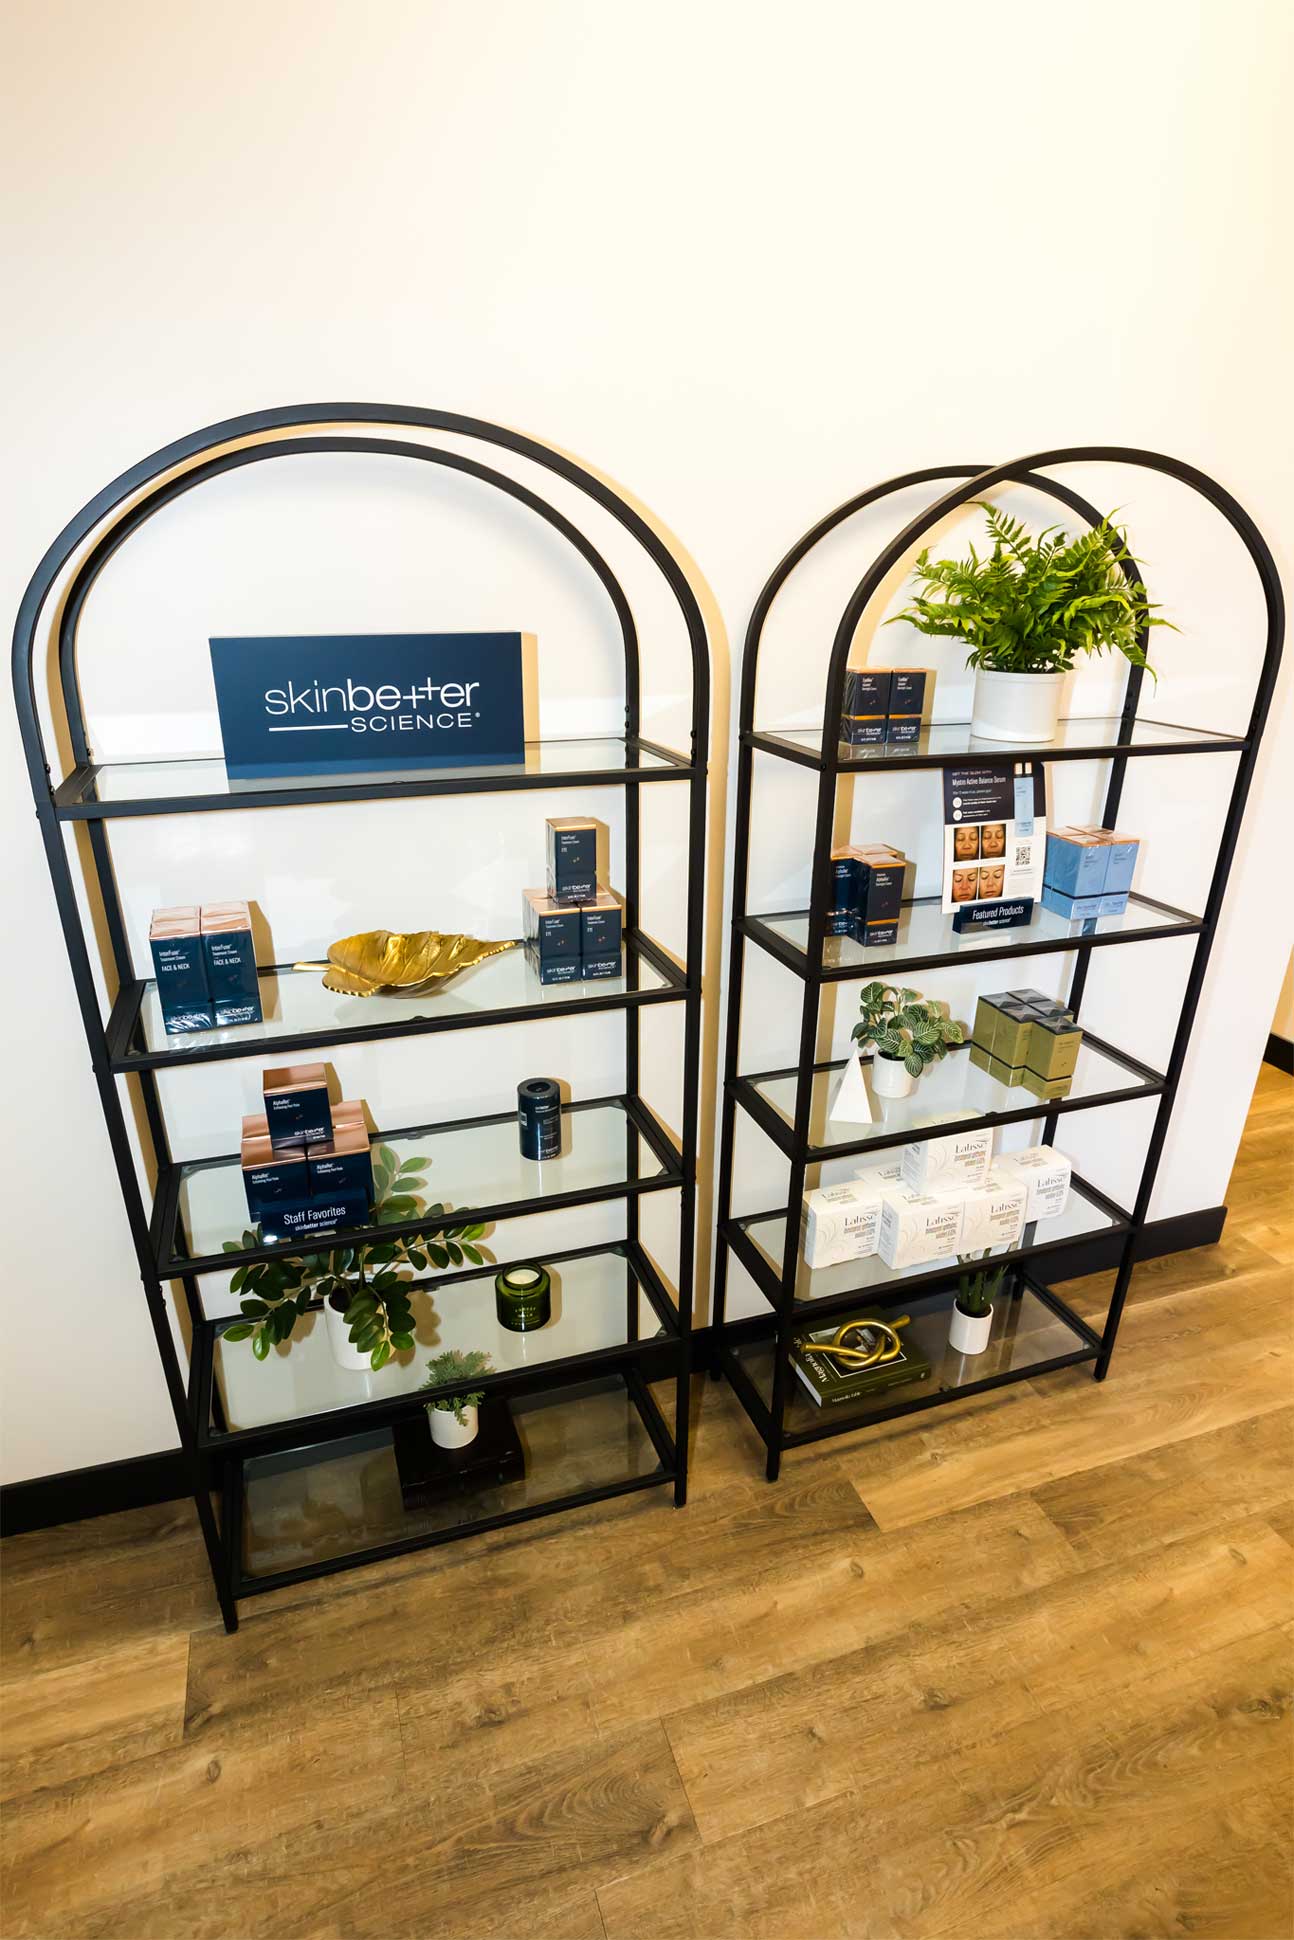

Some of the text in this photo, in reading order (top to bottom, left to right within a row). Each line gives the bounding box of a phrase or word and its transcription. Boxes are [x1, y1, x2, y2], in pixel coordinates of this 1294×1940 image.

[972, 905, 1024, 920] Featured Products
[229, 957, 241, 965] NECK
[283, 1205, 346, 1225] Staff Favorites
